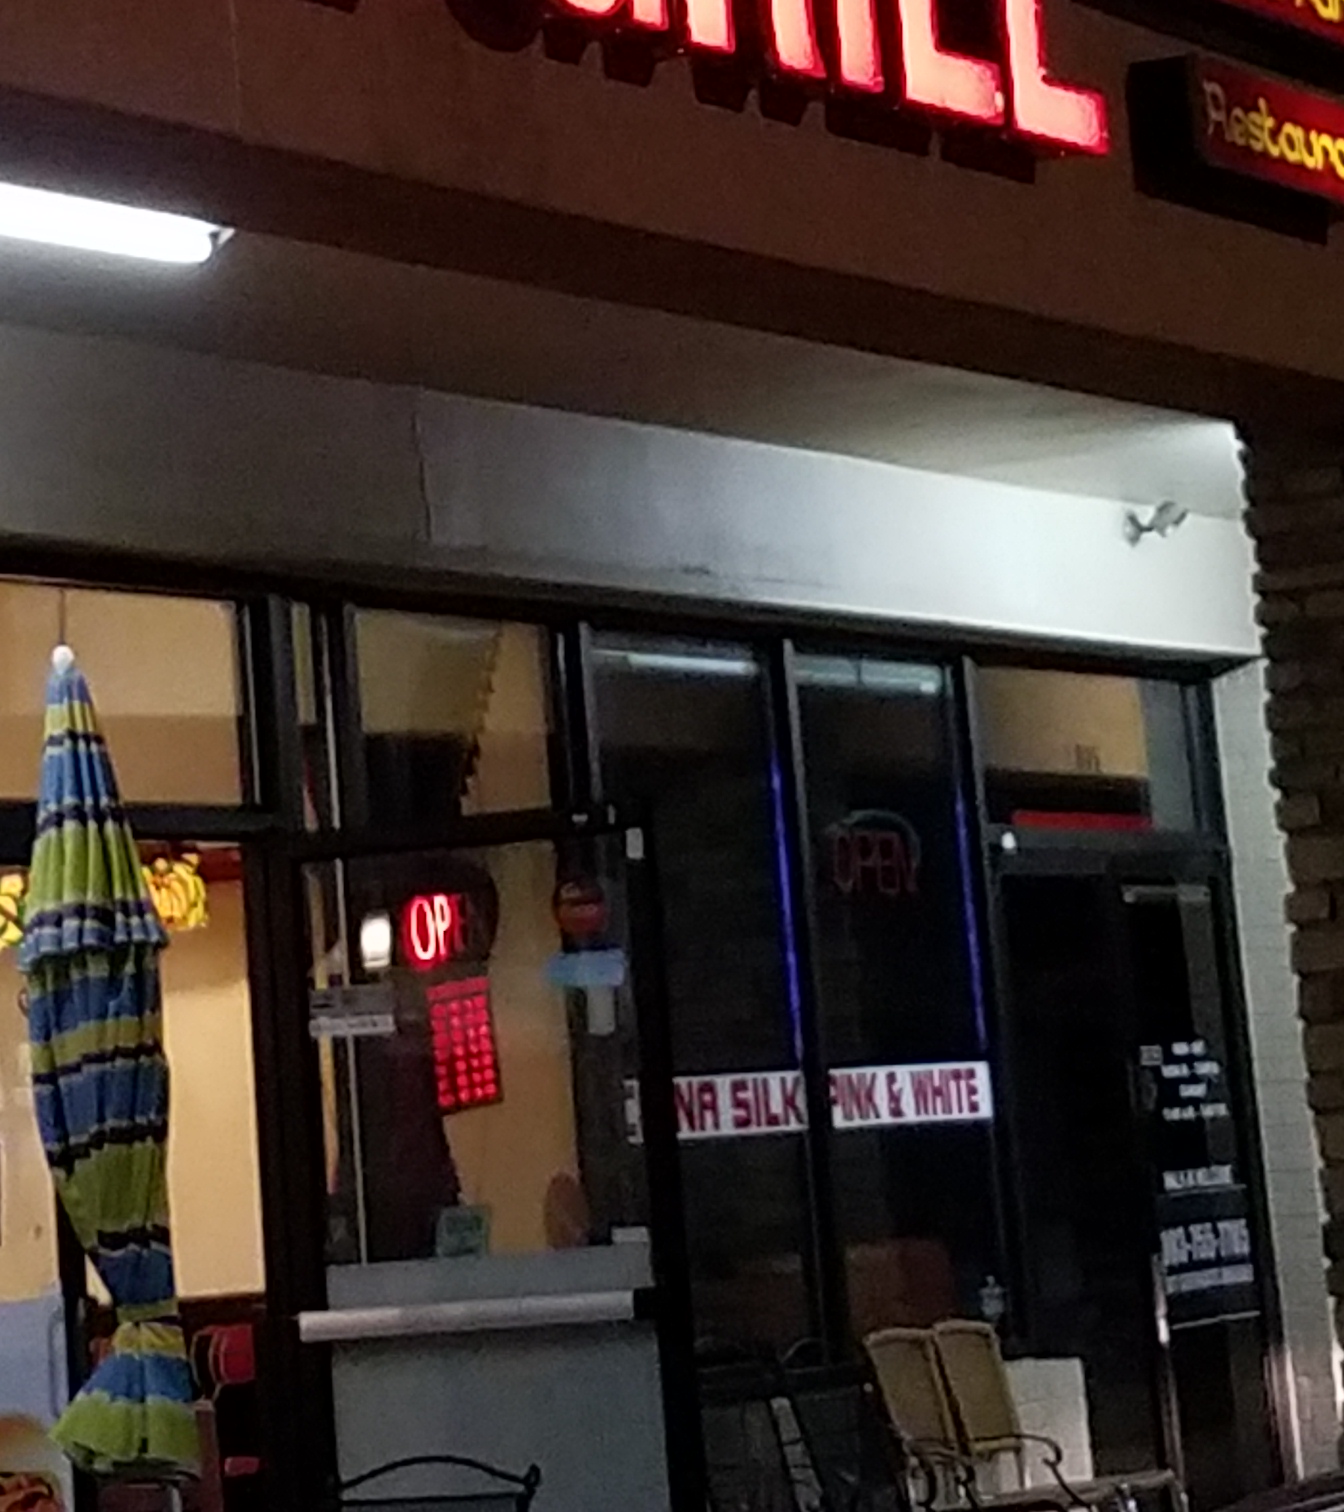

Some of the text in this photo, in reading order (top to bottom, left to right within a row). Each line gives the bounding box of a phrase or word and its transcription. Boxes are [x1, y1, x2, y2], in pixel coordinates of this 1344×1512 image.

[730, 1075, 805, 1129] SILK
[886, 1070, 905, 1118] &
[910, 1067, 980, 1118] WHITE
